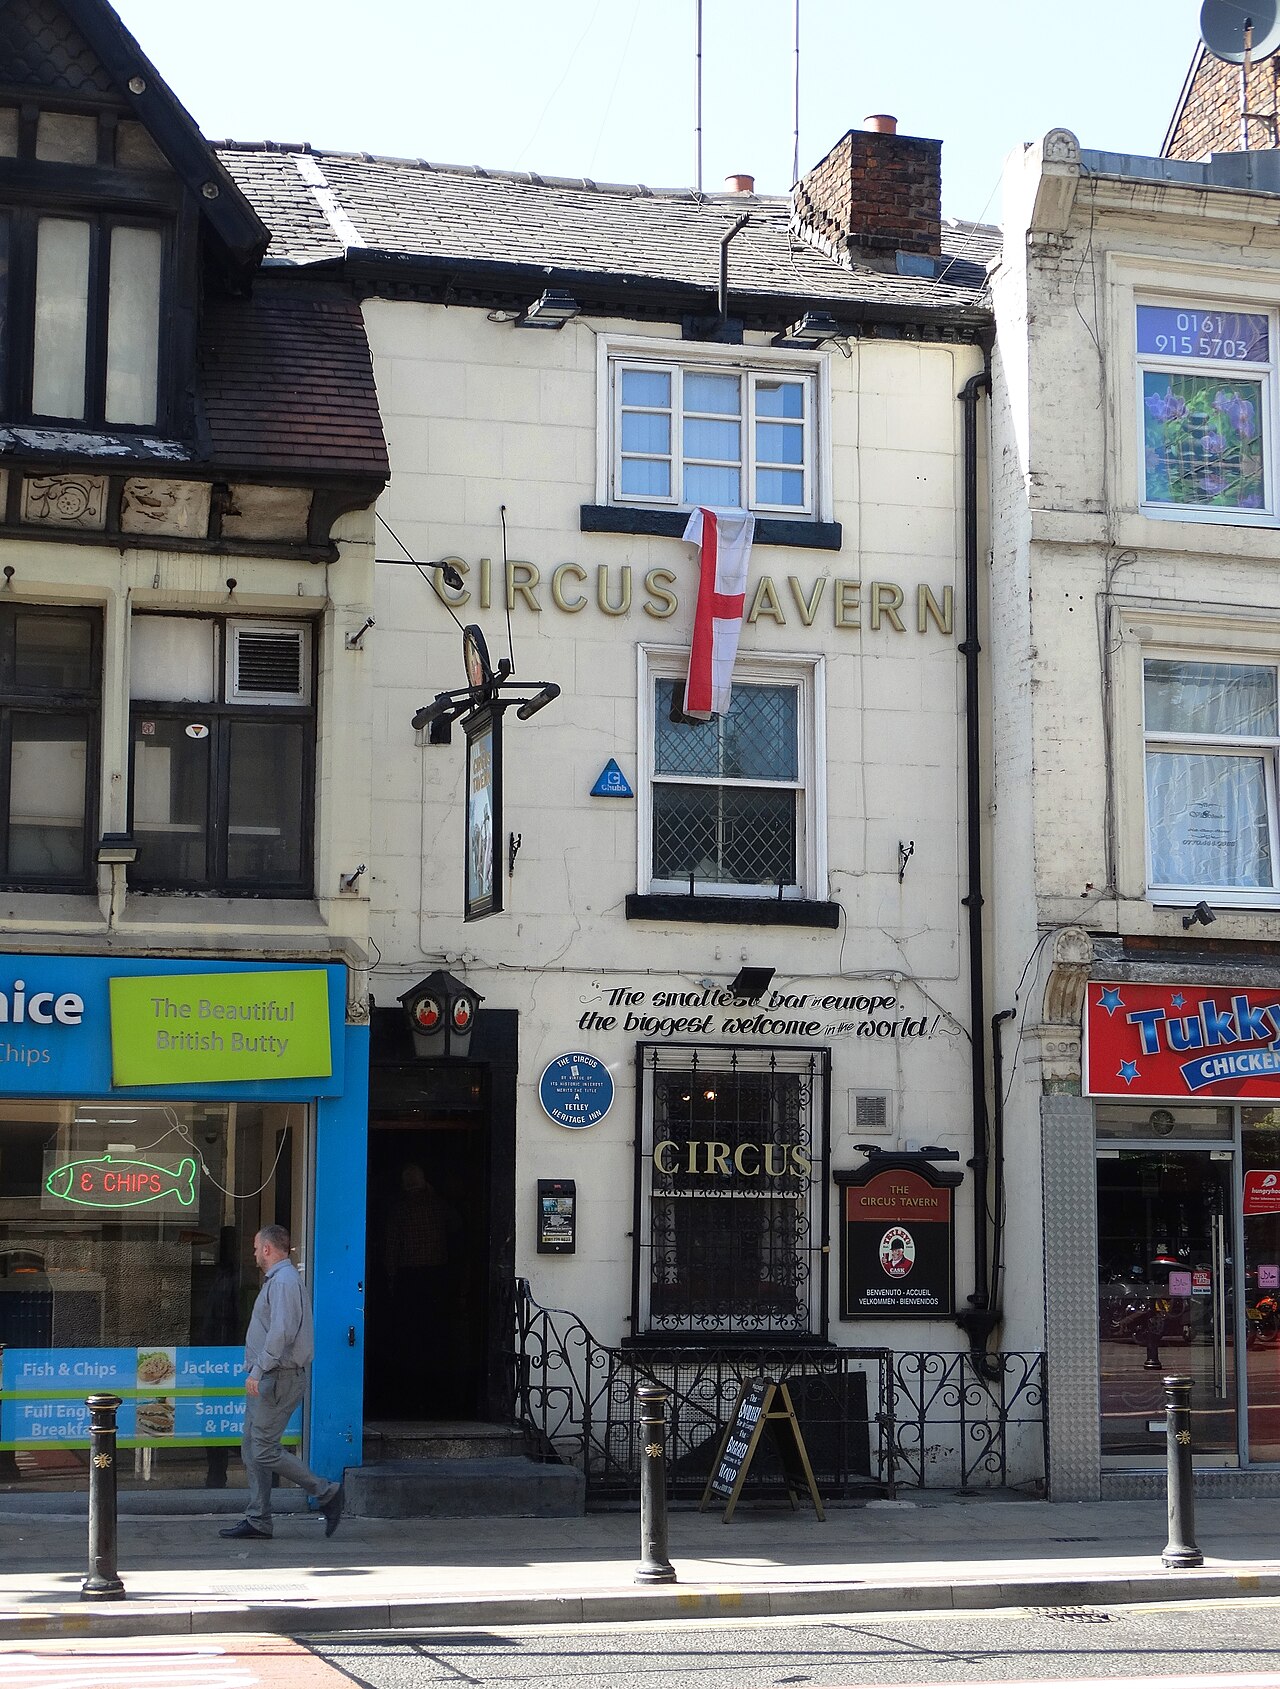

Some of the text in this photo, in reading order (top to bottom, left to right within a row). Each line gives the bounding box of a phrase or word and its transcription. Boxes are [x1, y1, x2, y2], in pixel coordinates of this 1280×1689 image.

[1177, 314, 1223, 334] 0161
[1155, 334, 1248, 358] 915 5703
[433, 556, 953, 634] CIRCUS AVERN
[601, 784, 627, 792] Chubb
[768, 991, 812, 1009] bar
[150, 998, 295, 1021] The Beautiful
[576, 1011, 617, 1031] the
[623, 1012, 716, 1036] biggest
[721, 1014, 824, 1036] welcome
[824, 1024, 836, 1036] in
[837, 1022, 855, 1034] the
[156, 1030, 289, 1057] British Butty
[556, 1055, 598, 1068] THE CIRCUS
[574, 1093, 580, 1101] A
[564, 1103, 589, 1111] TETLEY
[551, 1108, 602, 1124] HERITAGE INN
[653, 1140, 812, 1177] CIRCUS
[104, 1173, 161, 1193] CHIPS
[890, 1185, 909, 1194] THE
[860, 1197, 938, 1207] CIRCUS TAVERN
[866, 1288, 902, 1296] BENVENUTO
[858, 1297, 939, 1305] VELKOMMEN BIENVENIDOS
[23, 1361, 117, 1381] Fish & Chips
[181, 1360, 230, 1374] Jacket
[24, 1405, 51, 1418] Full
[205, 1420, 217, 1433] &
